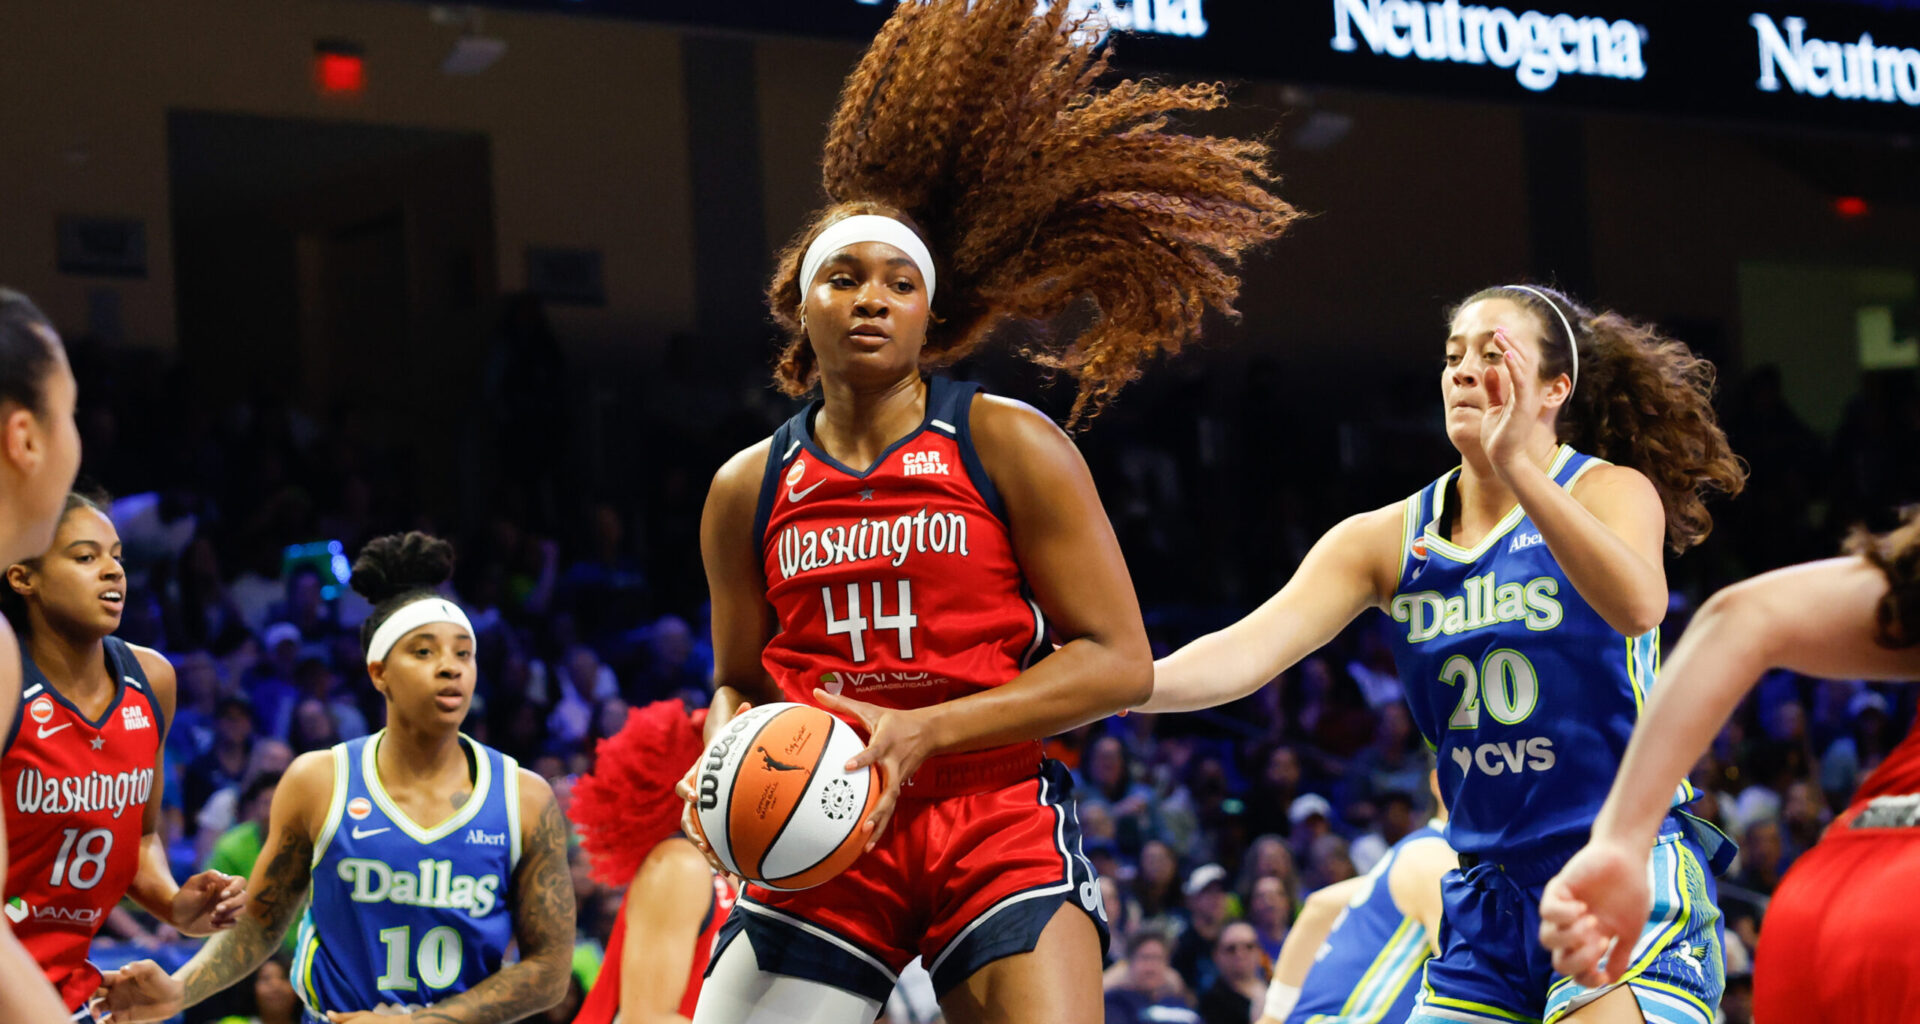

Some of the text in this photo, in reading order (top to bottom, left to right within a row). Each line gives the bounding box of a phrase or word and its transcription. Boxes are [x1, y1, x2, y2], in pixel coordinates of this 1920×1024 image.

[1331, 0, 1647, 91] Neutrogena
[1749, 13, 1920, 106] Neutro
[903, 450, 940, 465] CAR
[904, 461, 949, 476] max
[778, 504, 969, 580] Washington
[1508, 532, 1544, 554] Alber
[822, 579, 918, 663] 44
[1391, 571, 1563, 643] Dallas
[121, 705, 142, 720] CAR
[1438, 648, 1539, 730] 20
[124, 715, 151, 731] max
[1475, 736, 1557, 776] CVS
[16, 766, 154, 819] Washington
[49, 828, 114, 890] 18
[465, 829, 506, 846] Albert
[337, 858, 500, 918] Dallas
[377, 925, 463, 991] 10
